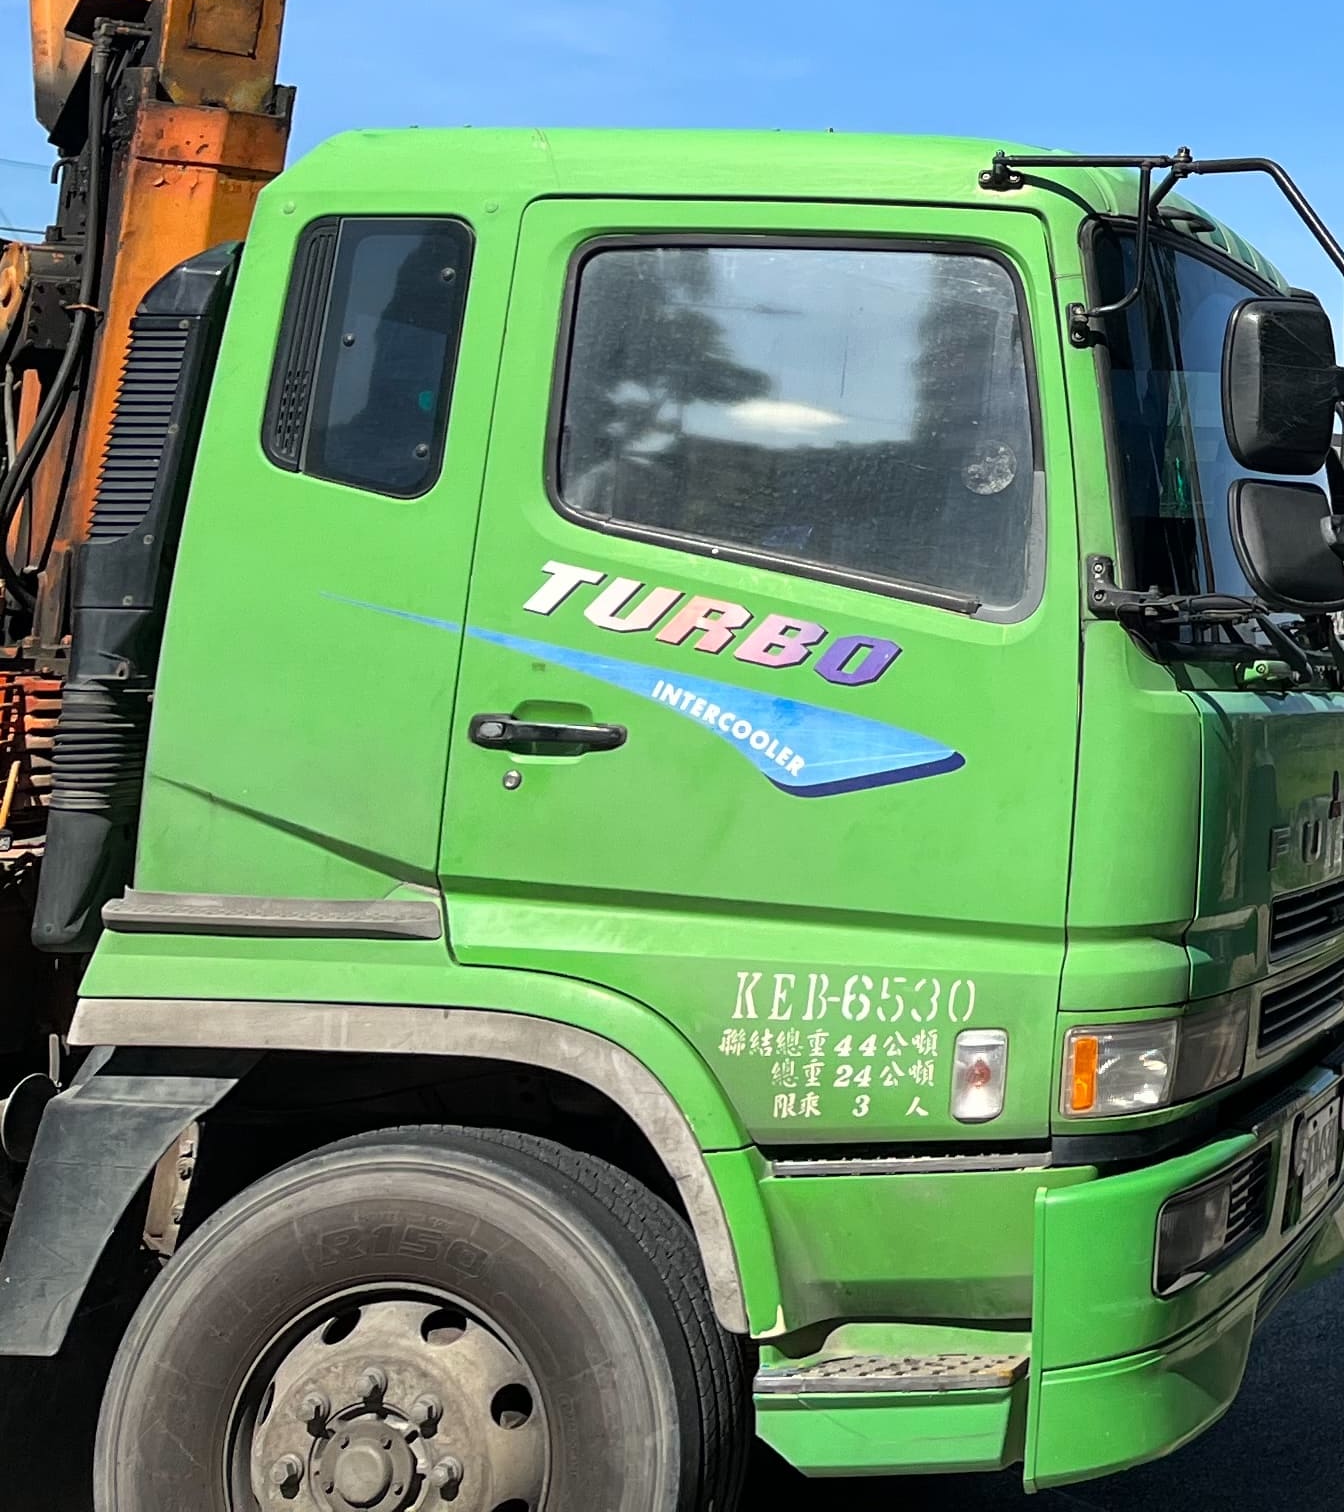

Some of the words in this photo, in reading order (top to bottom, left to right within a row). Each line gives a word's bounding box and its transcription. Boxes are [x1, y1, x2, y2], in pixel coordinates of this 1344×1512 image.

[522, 560, 904, 687] TURBO
[651, 679, 806, 778] INTERCOOLER
[731, 971, 976, 1023] KEB-6530
